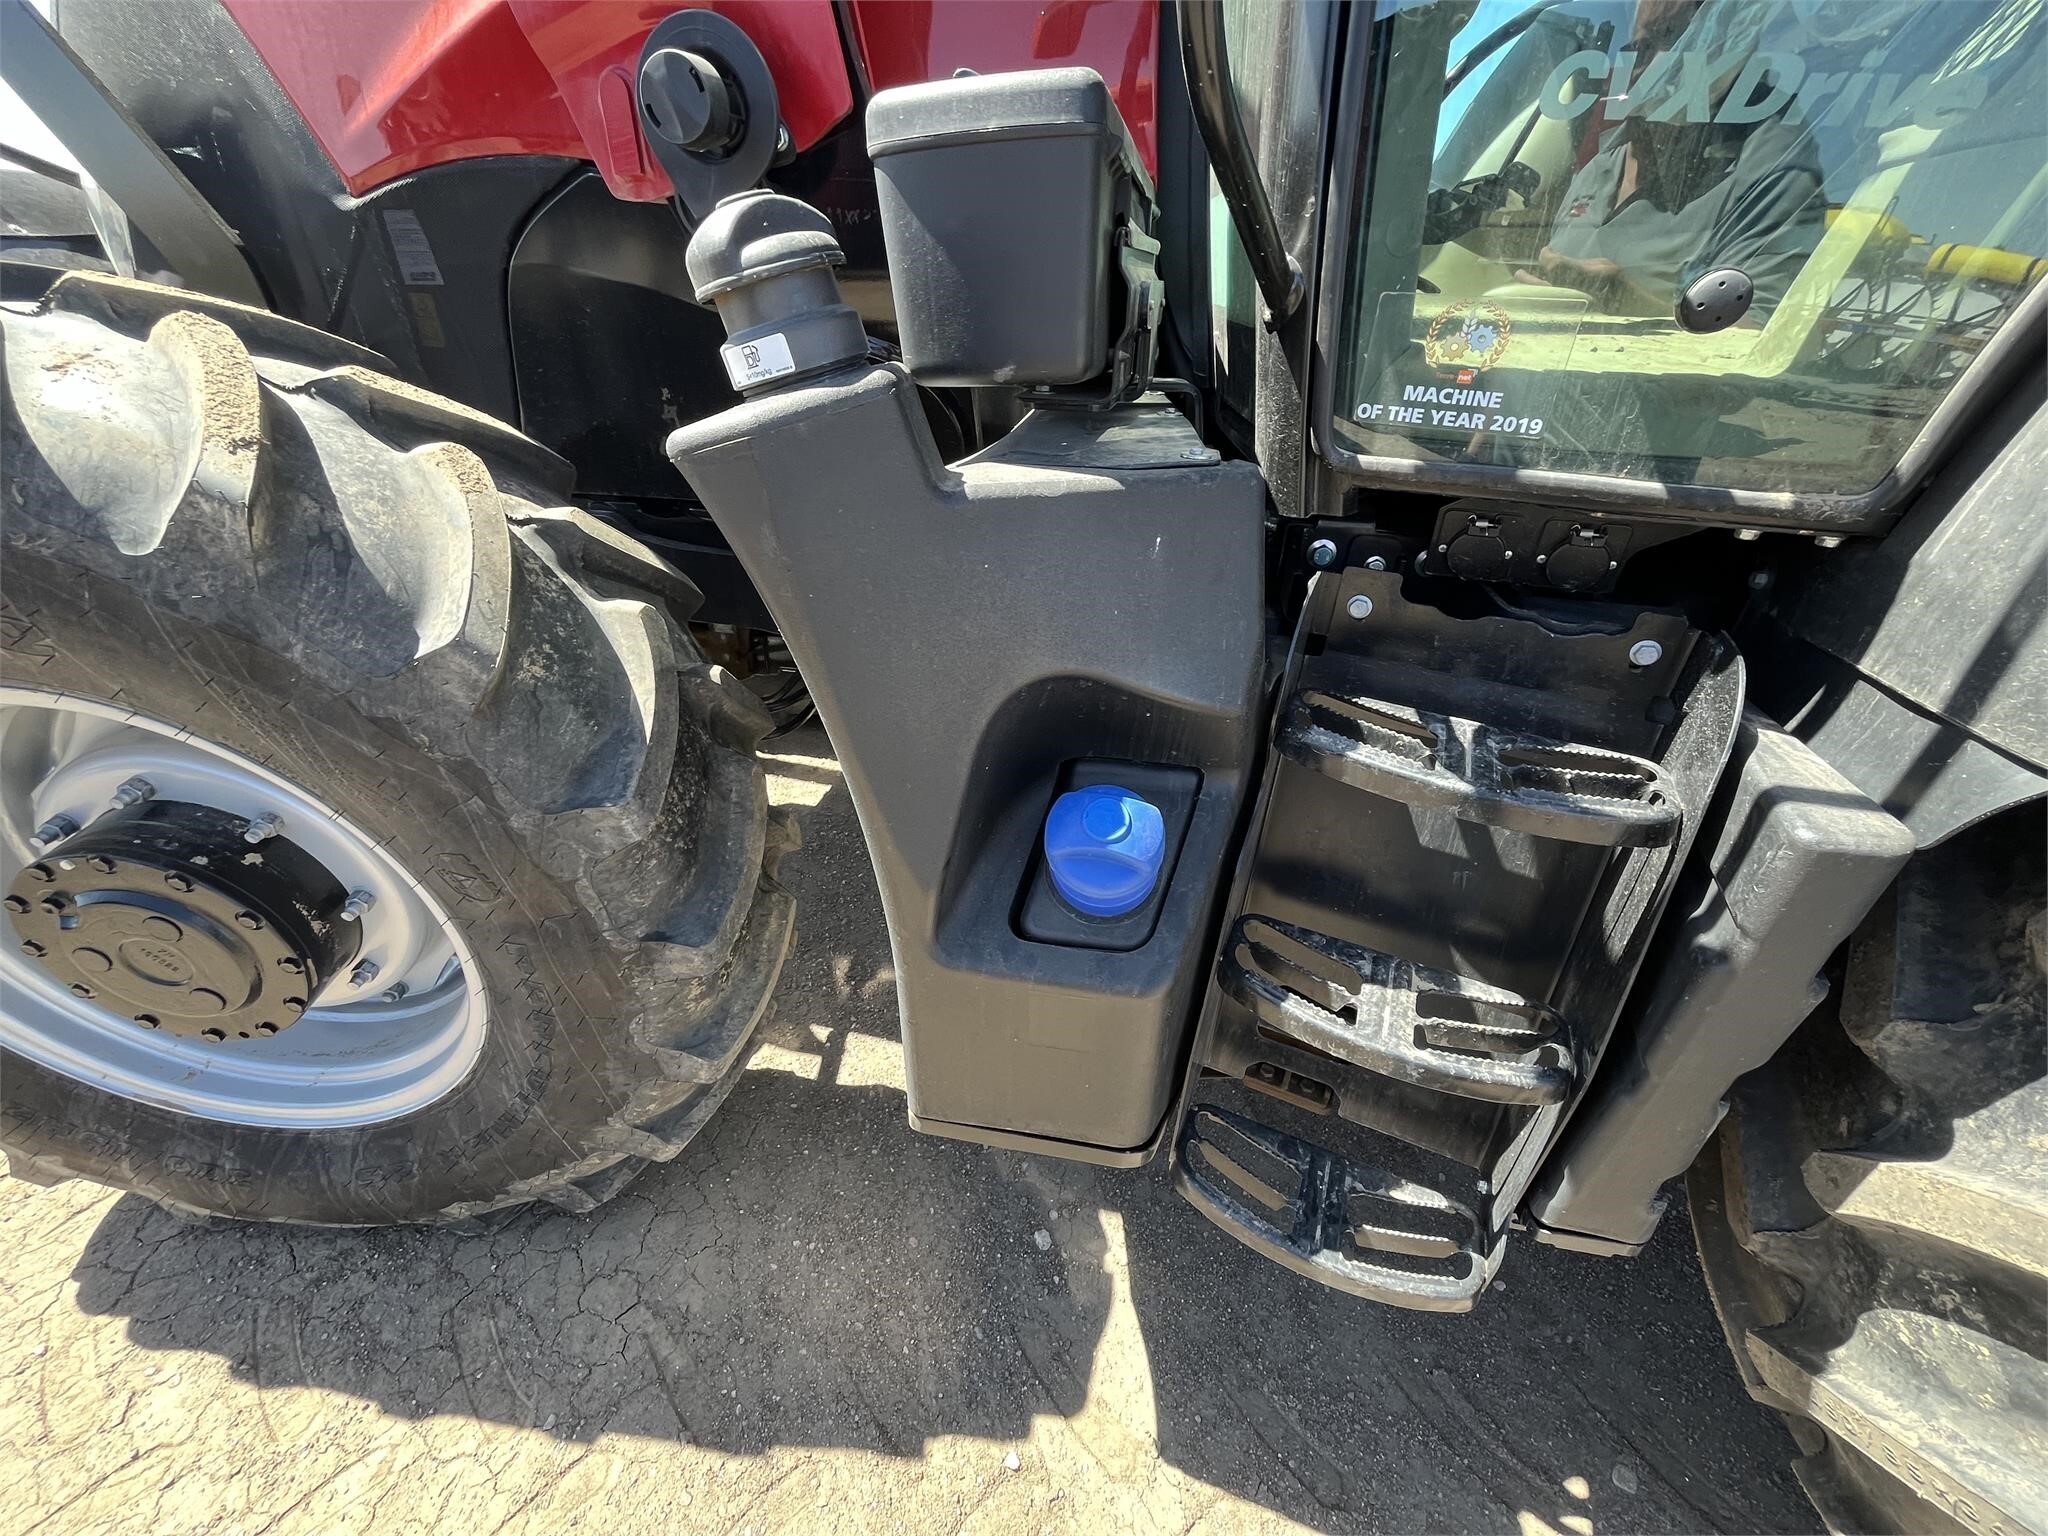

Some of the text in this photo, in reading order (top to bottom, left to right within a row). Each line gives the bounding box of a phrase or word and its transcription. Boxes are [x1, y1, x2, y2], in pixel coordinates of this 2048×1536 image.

[1538, 48, 1990, 131] CVXDrive
[1403, 385, 1504, 409] MACHINE
[1357, 403, 1544, 435] OF THE YEAR 2019
